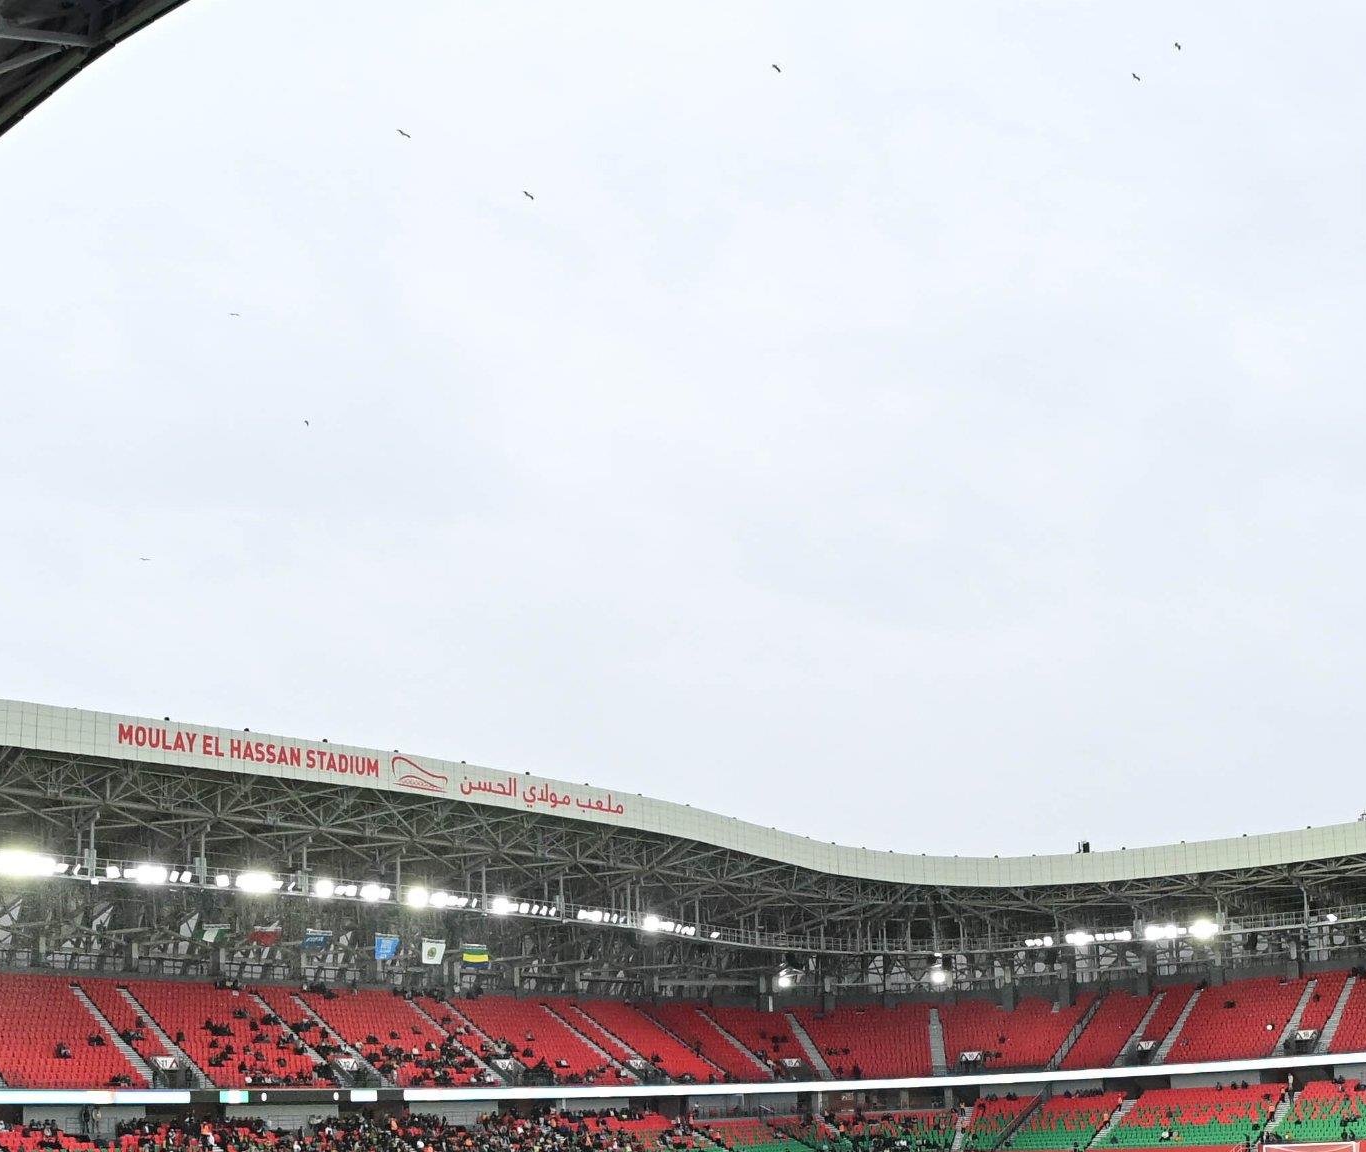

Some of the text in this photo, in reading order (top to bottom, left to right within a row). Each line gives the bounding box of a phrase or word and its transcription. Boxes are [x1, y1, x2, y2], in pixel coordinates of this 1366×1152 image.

[118, 723, 379, 778] MOULAY EL HASSAN STADIUM
[460, 776, 624, 815] ملعب مولاي الحسن
